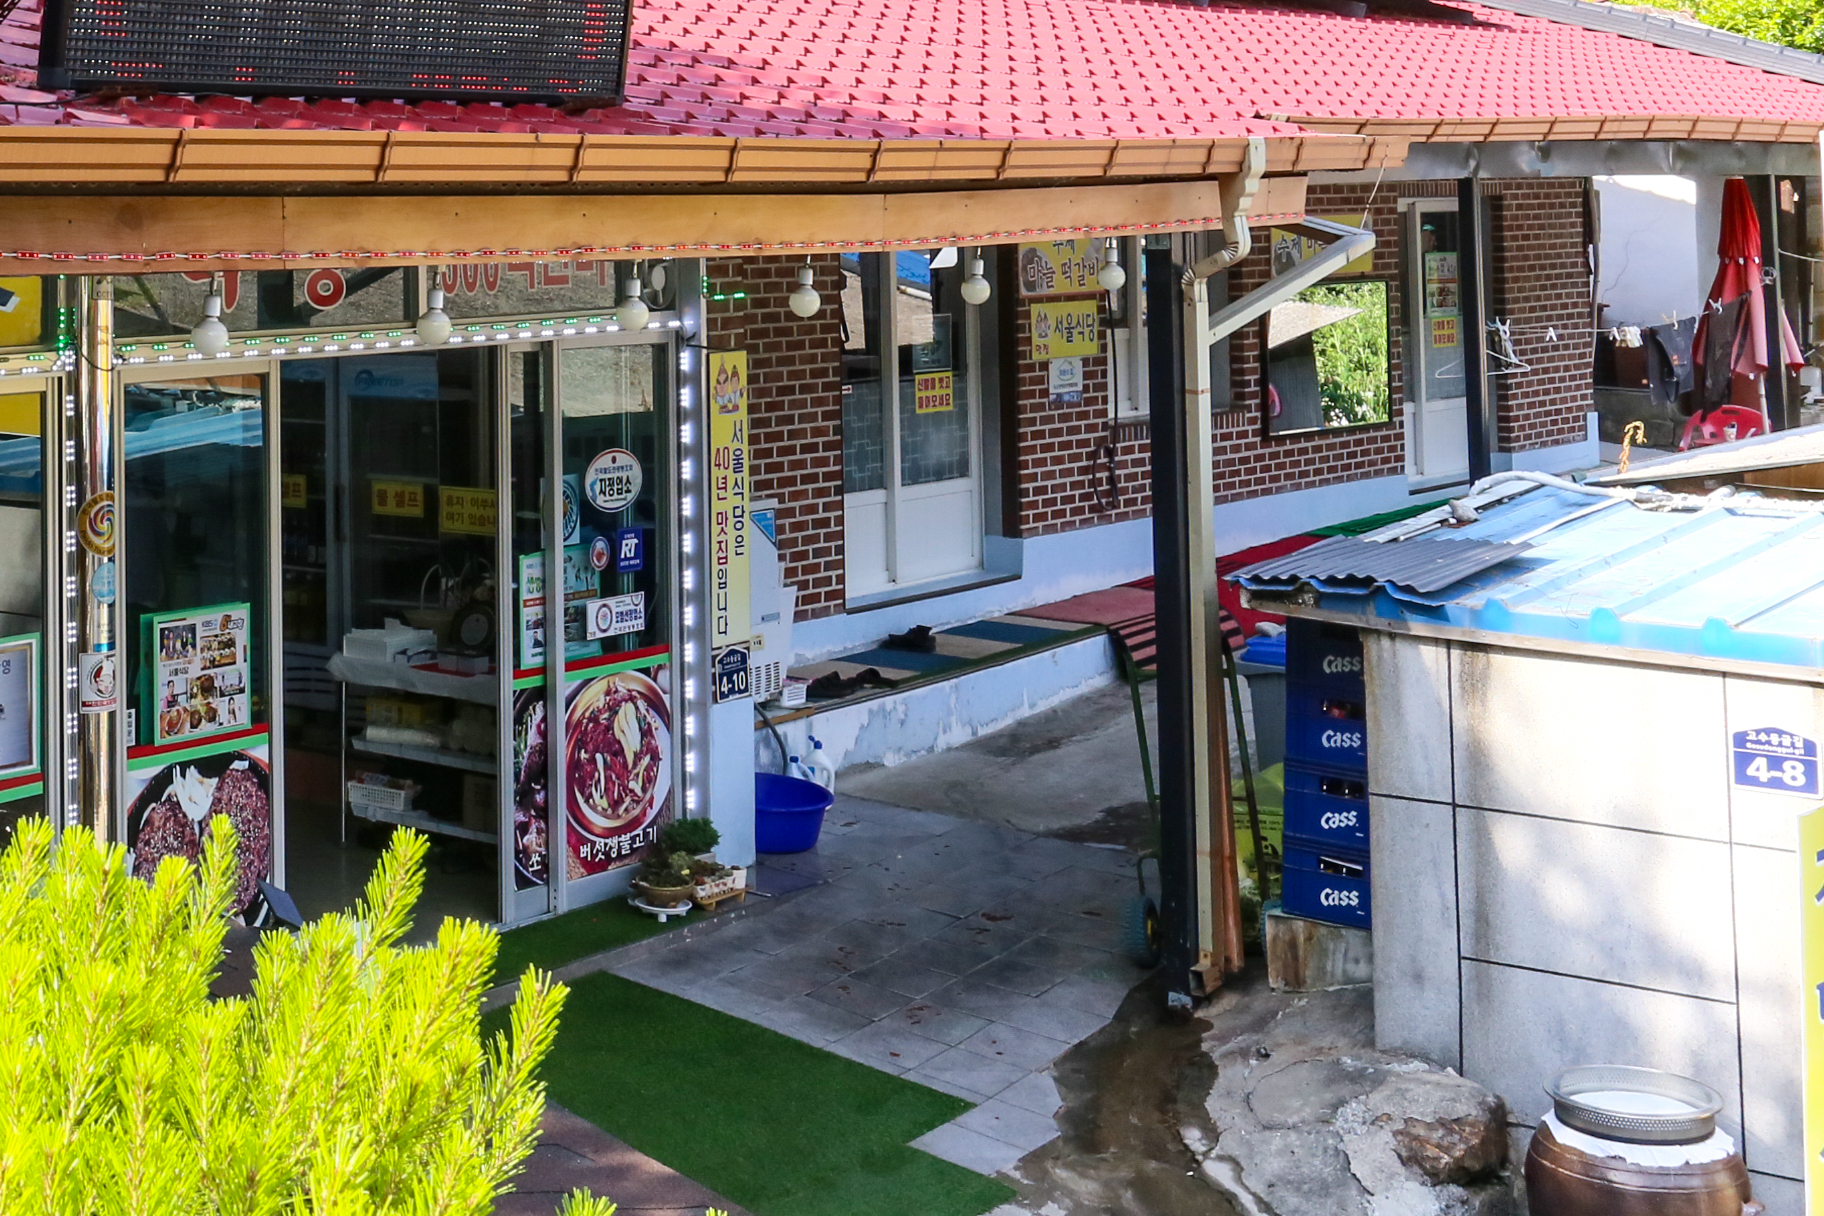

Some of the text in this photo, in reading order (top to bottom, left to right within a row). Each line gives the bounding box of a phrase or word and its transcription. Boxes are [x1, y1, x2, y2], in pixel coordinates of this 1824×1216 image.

[1028, 256, 1099, 290] 마늘 떡갈비
[1053, 311, 1096, 344] 서울식당
[598, 474, 632, 497] 지정업소
[731, 419, 746, 557] 서울식당은
[393, 489, 420, 508] 셀프
[467, 512, 495, 528] 있습니
[620, 538, 639, 559] RT
[714, 446, 731, 636] 40년 맛집입니다
[1322, 655, 1362, 674] Cass
[720, 670, 746, 695] 4-10
[1321, 729, 1362, 749] Cass
[1745, 755, 1807, 787] 4-8
[1320, 810, 1358, 830] Cass
[1319, 887, 1360, 907] Cass
